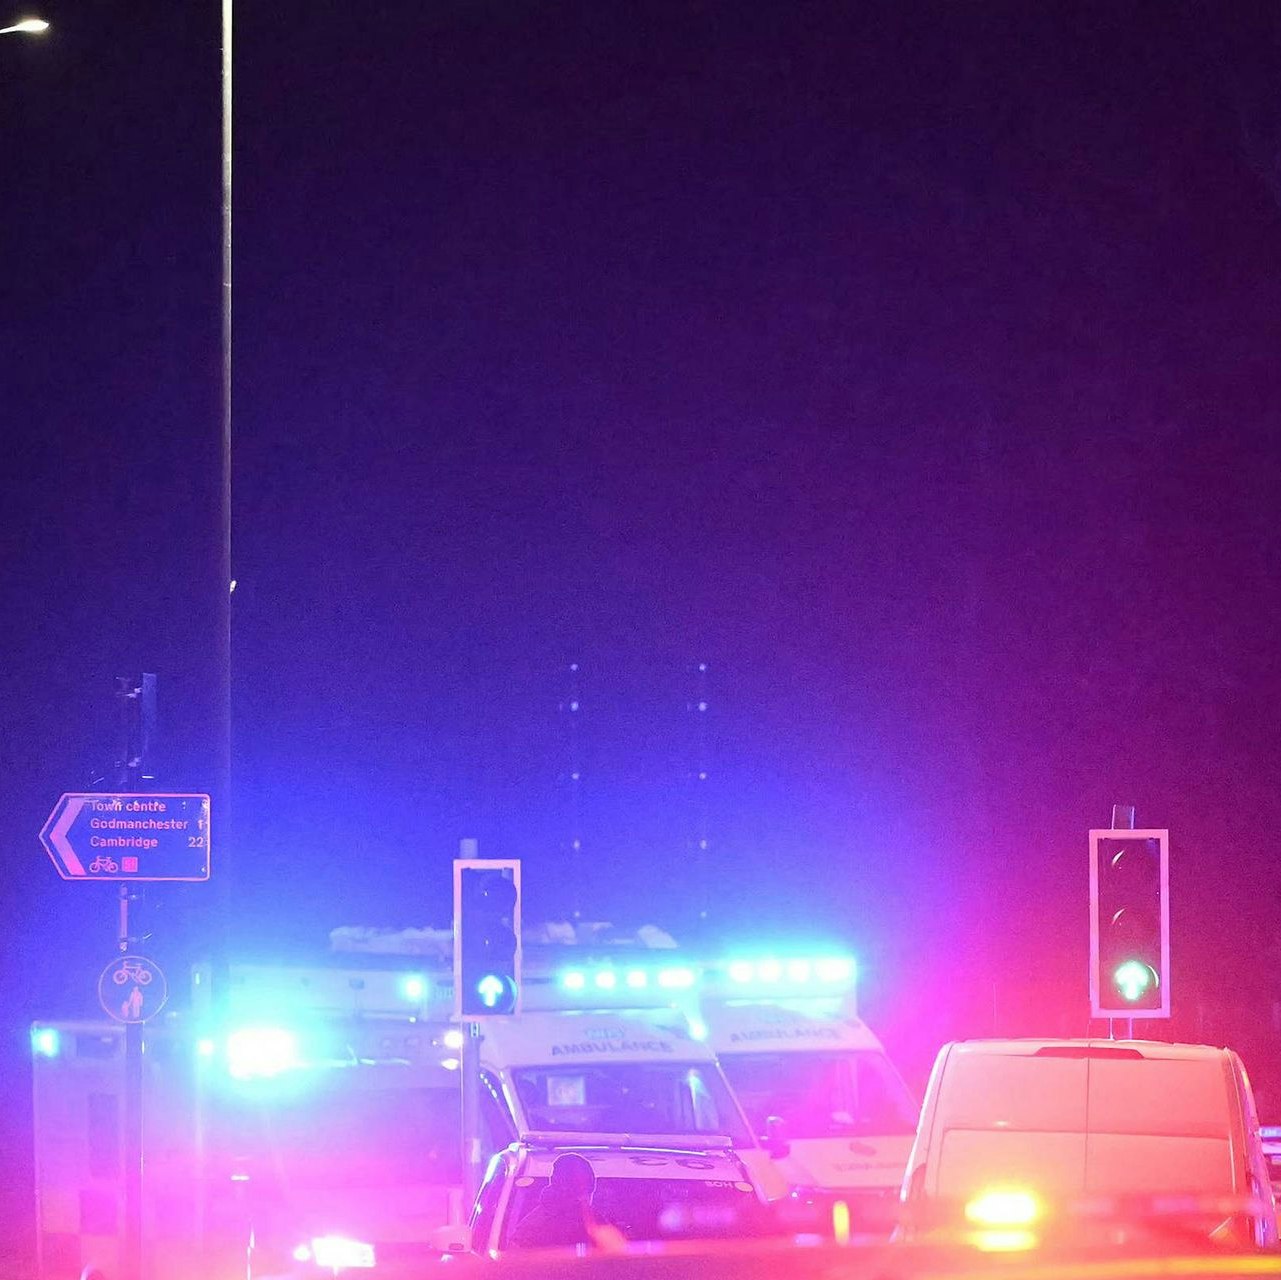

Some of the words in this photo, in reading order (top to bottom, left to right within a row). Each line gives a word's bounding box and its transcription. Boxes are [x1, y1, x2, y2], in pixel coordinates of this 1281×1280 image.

[91, 799, 122, 811] Town
[126, 801, 167, 811] centre
[90, 818, 188, 829] Godmanchester
[90, 835, 158, 849] Cambridge
[188, 836, 203, 847] 22
